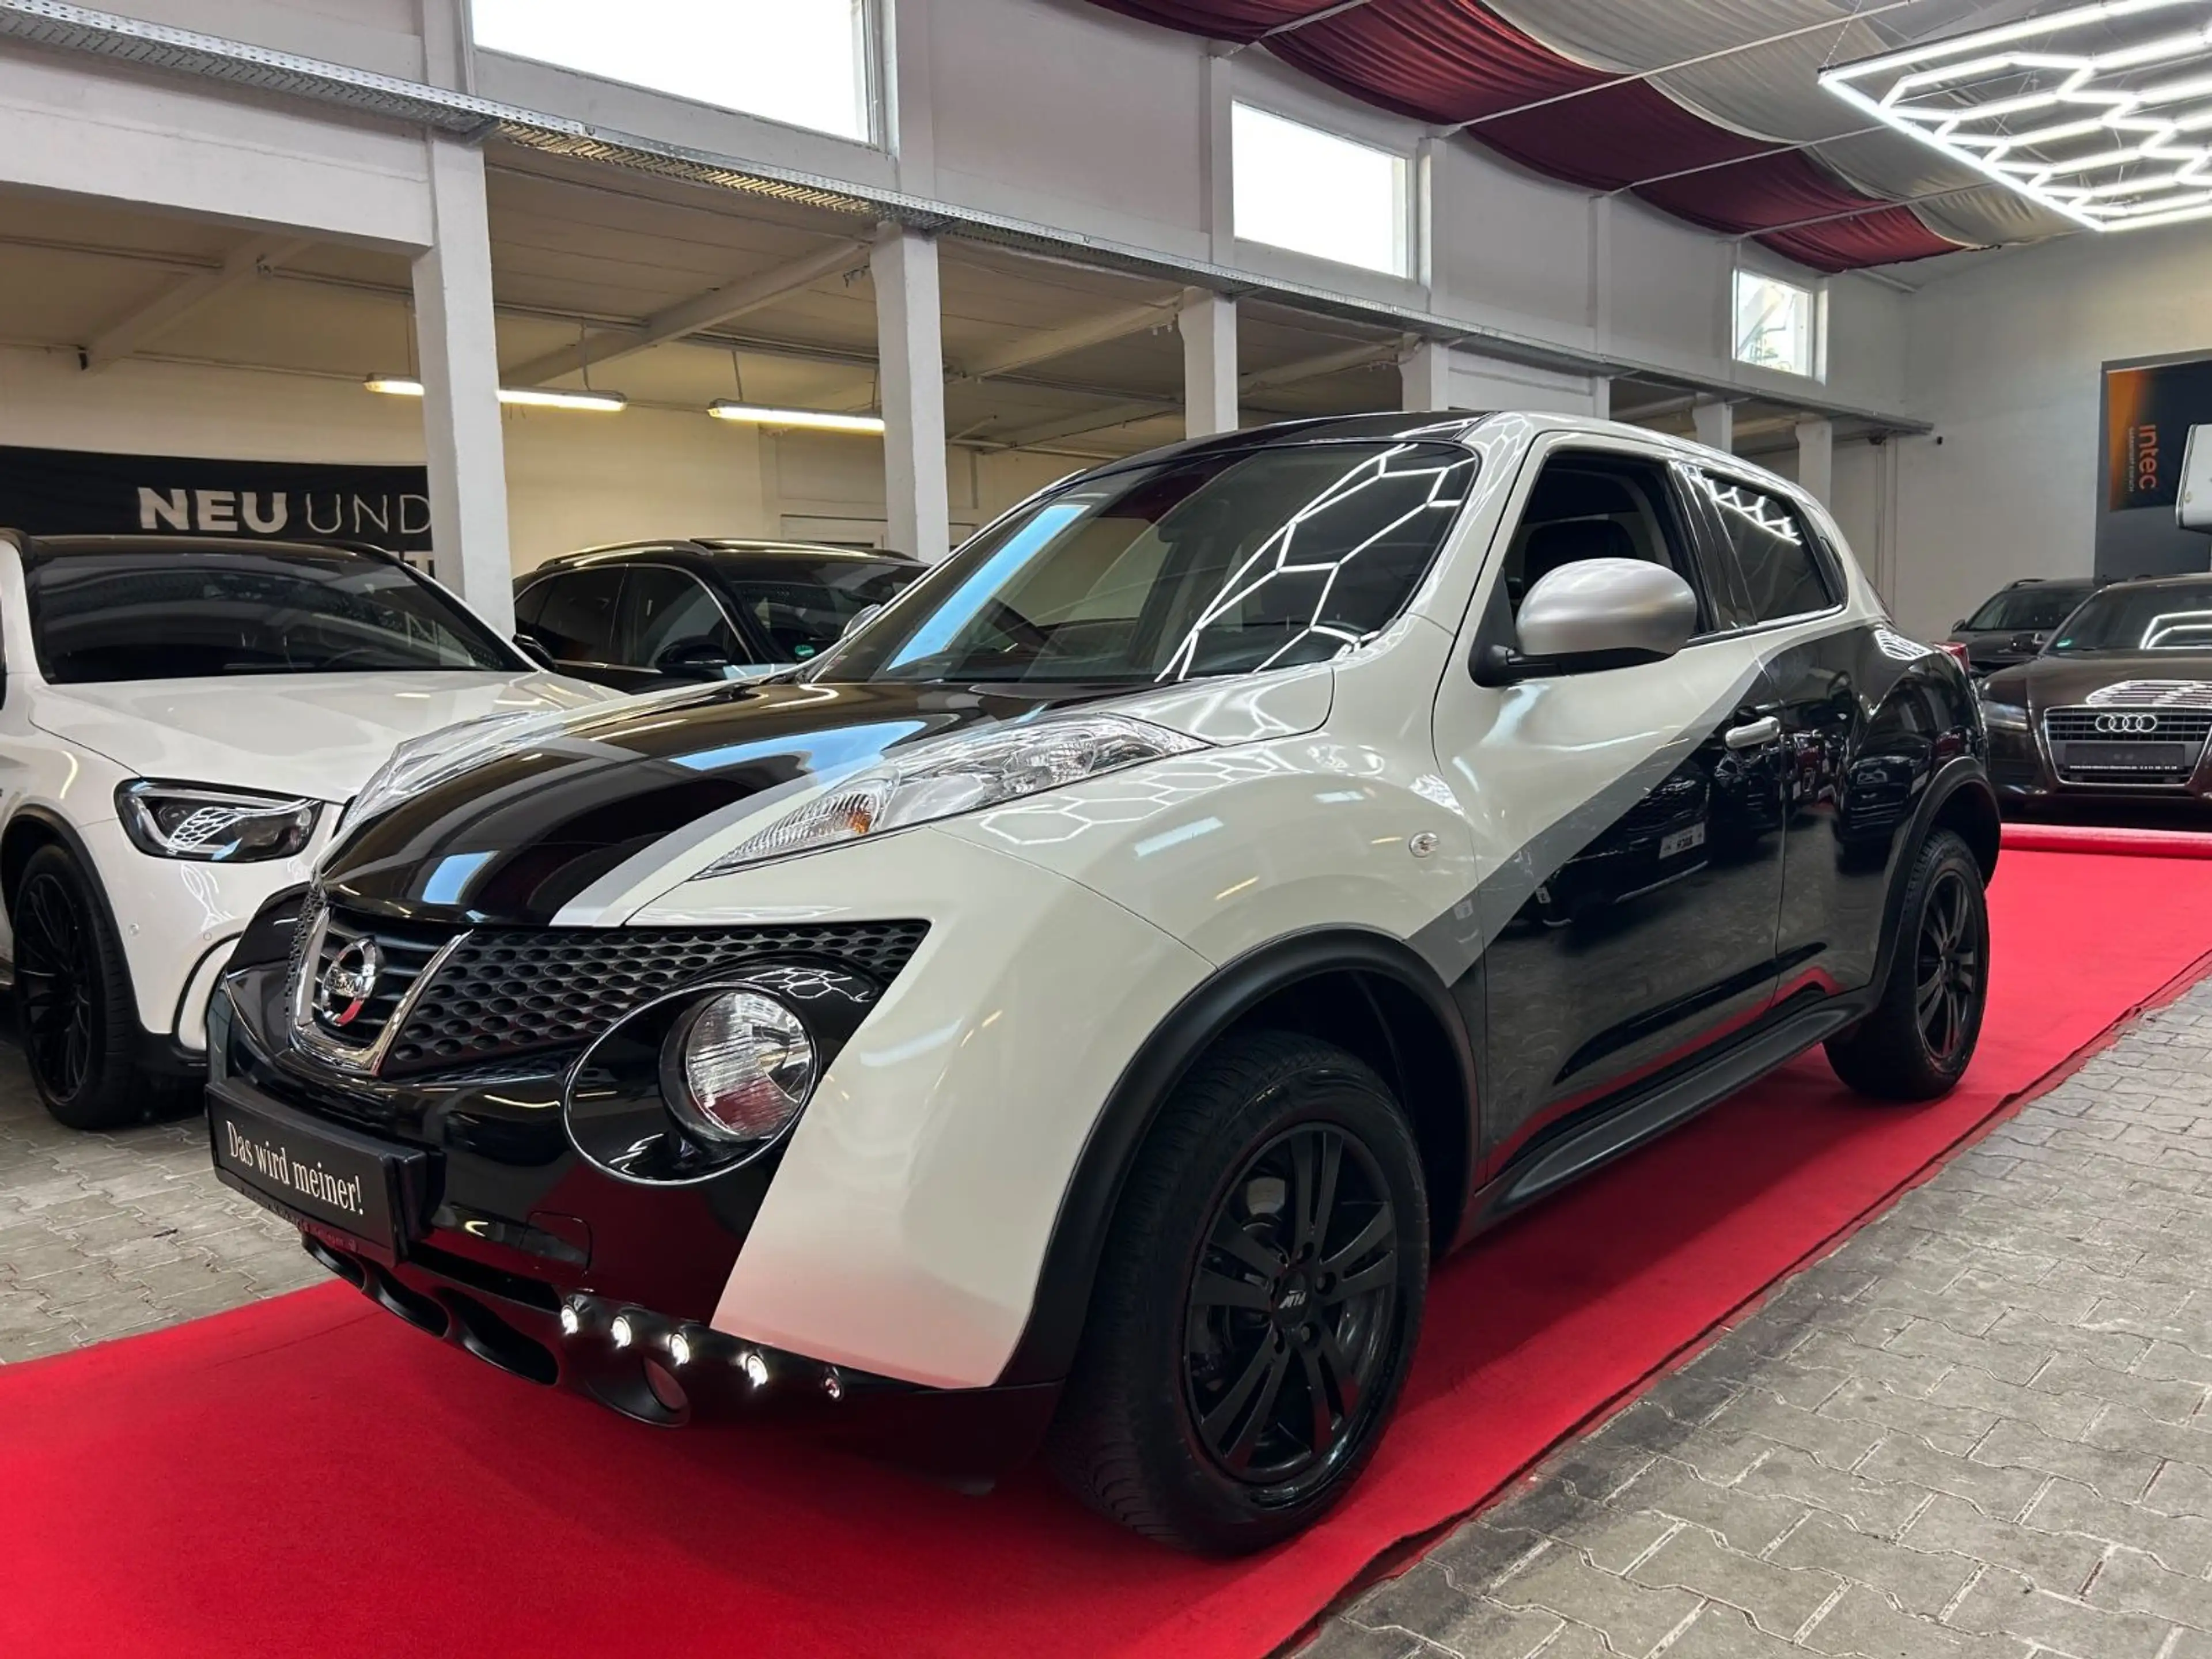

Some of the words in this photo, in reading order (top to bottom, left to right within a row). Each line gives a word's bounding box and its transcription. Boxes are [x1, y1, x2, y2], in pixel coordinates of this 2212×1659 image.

[138, 487, 287, 533] NEU
[306, 493, 431, 533] UND
[226, 1120, 254, 1166] Das
[254, 1141, 290, 1185] wird
[292, 1161, 363, 1215] meiner!
